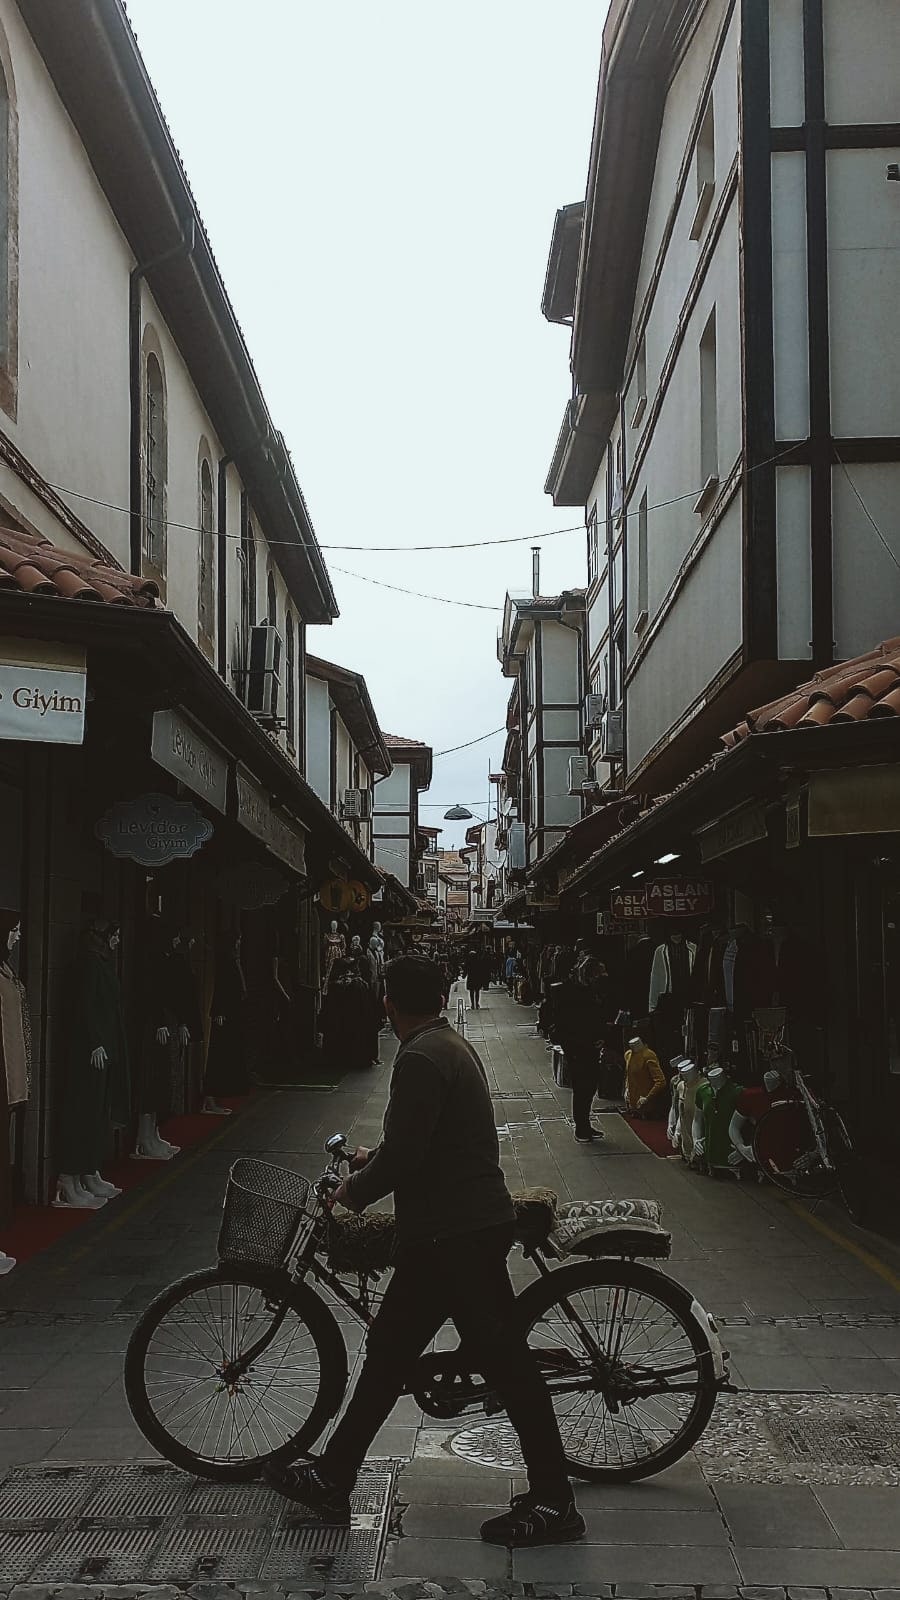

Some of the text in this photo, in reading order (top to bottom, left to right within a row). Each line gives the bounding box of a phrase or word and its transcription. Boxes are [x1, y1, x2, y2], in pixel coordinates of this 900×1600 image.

[12, 687, 83, 717] Giyim
[650, 883, 710, 897] ASLAN
[614, 895, 646, 906] ASLA
[663, 898, 699, 912] BEY
[623, 906, 648, 917] BEY
